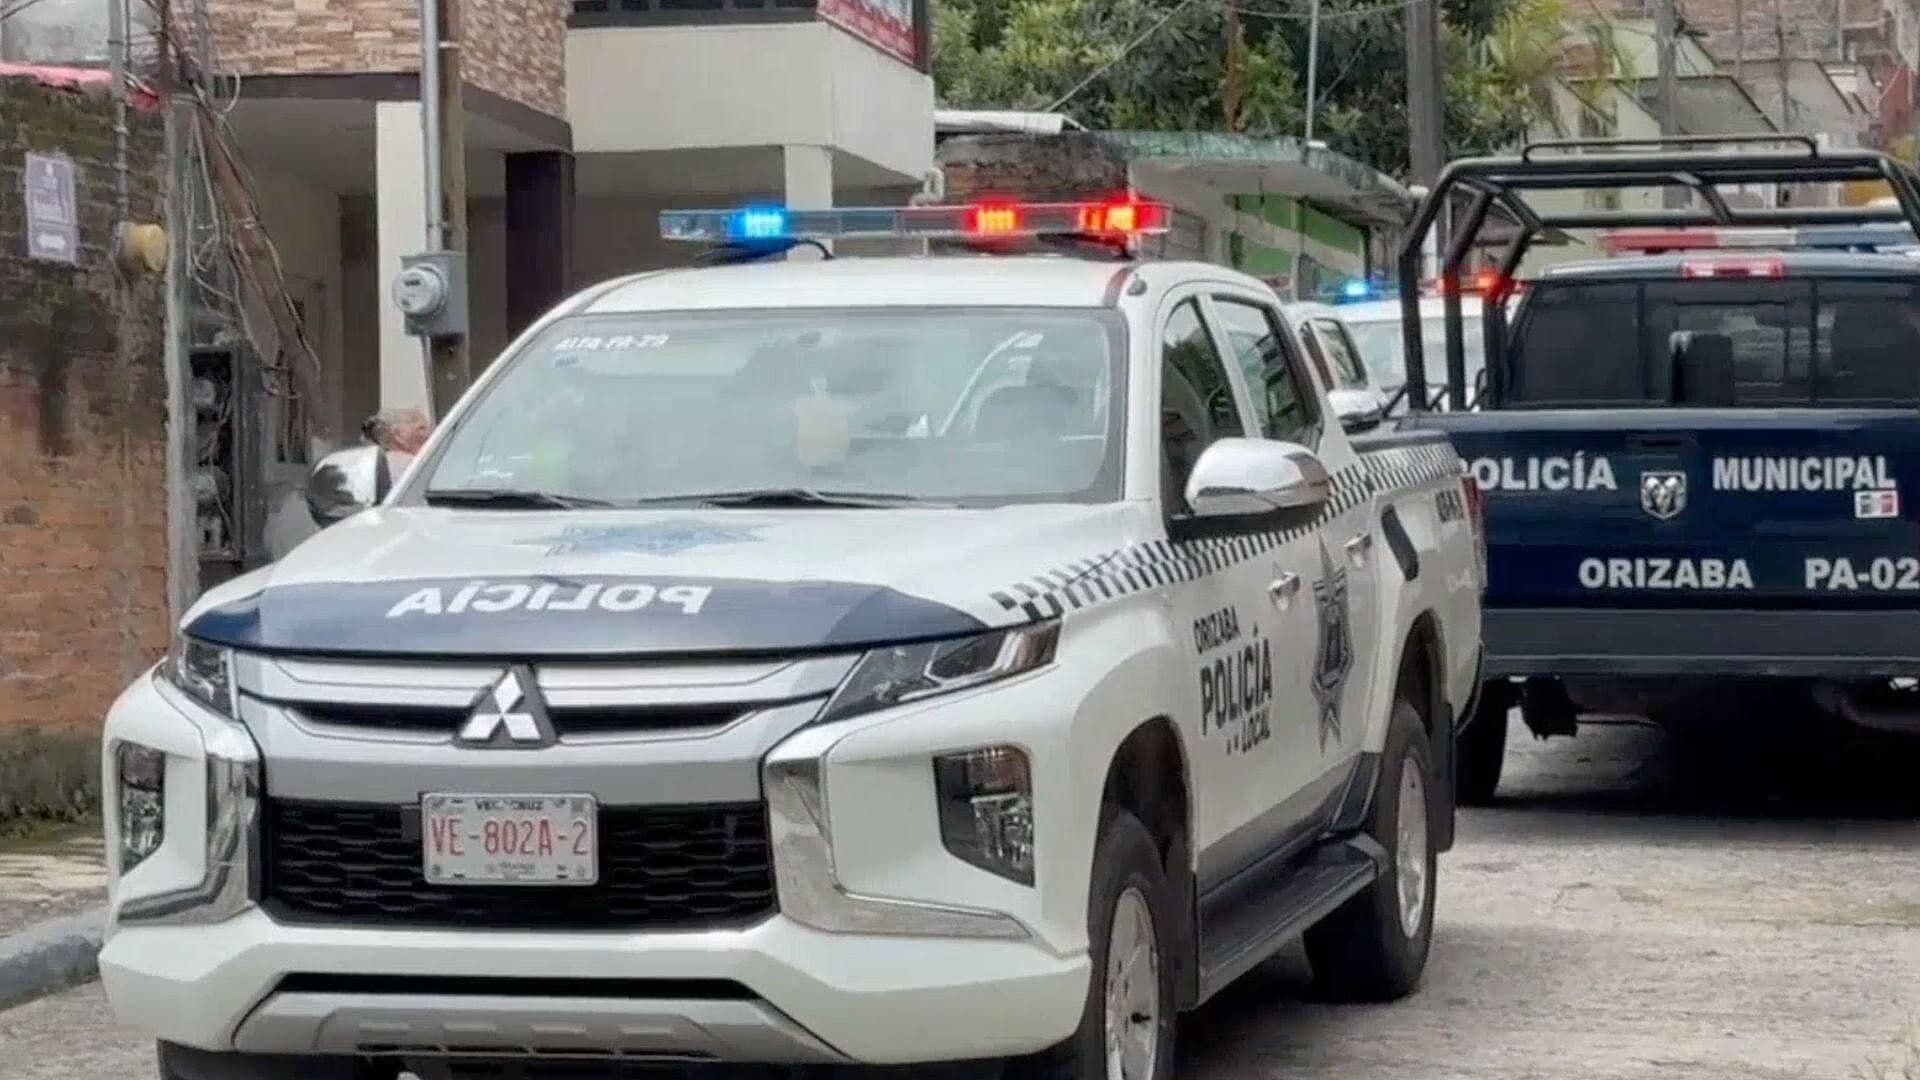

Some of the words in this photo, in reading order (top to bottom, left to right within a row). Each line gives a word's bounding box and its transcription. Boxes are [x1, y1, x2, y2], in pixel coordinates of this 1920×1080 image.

[1712, 456, 1896, 491] MUNICIPAL
[1578, 557, 1754, 589] ORIZABA
[1804, 557, 1920, 590] PA-02
[1200, 621, 1272, 736] POLICÍA
[431, 818, 588, 857] VE-802A-2
